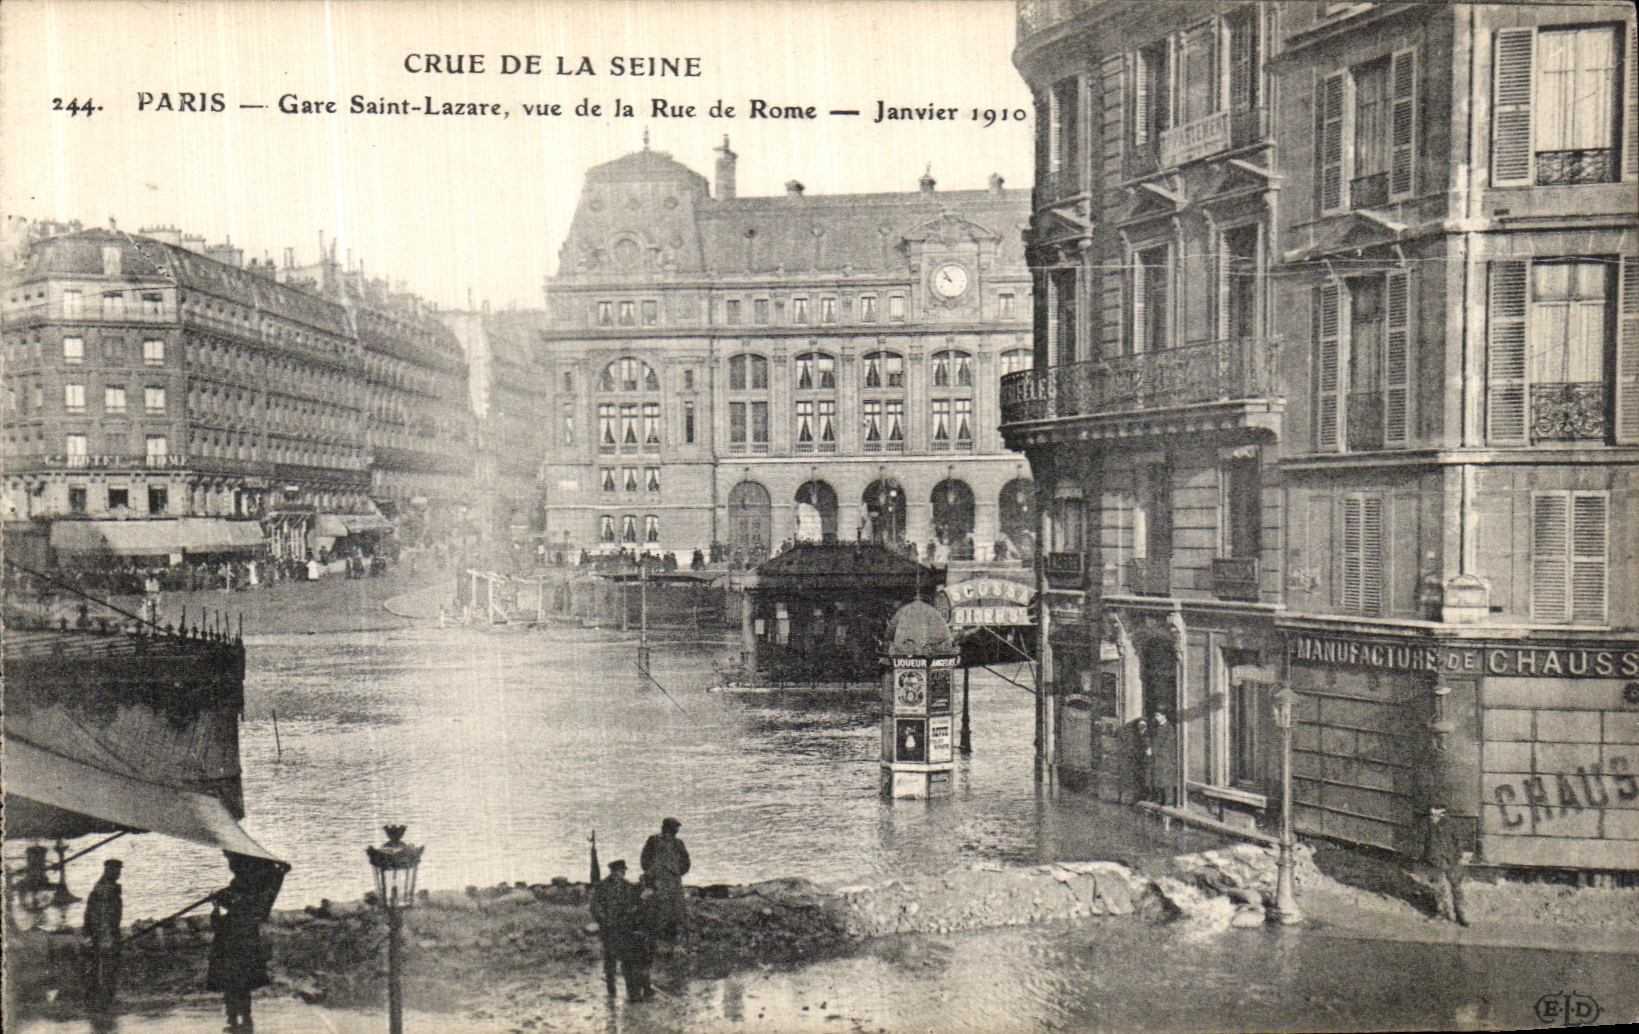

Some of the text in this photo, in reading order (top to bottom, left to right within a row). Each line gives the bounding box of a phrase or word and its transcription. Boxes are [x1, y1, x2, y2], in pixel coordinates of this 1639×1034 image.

[893, 658, 927, 668] LIQUEUR
[1297, 637, 1639, 676] MANUFACTURE DE CHAUSS
[1494, 755, 1639, 828] CHAUS
